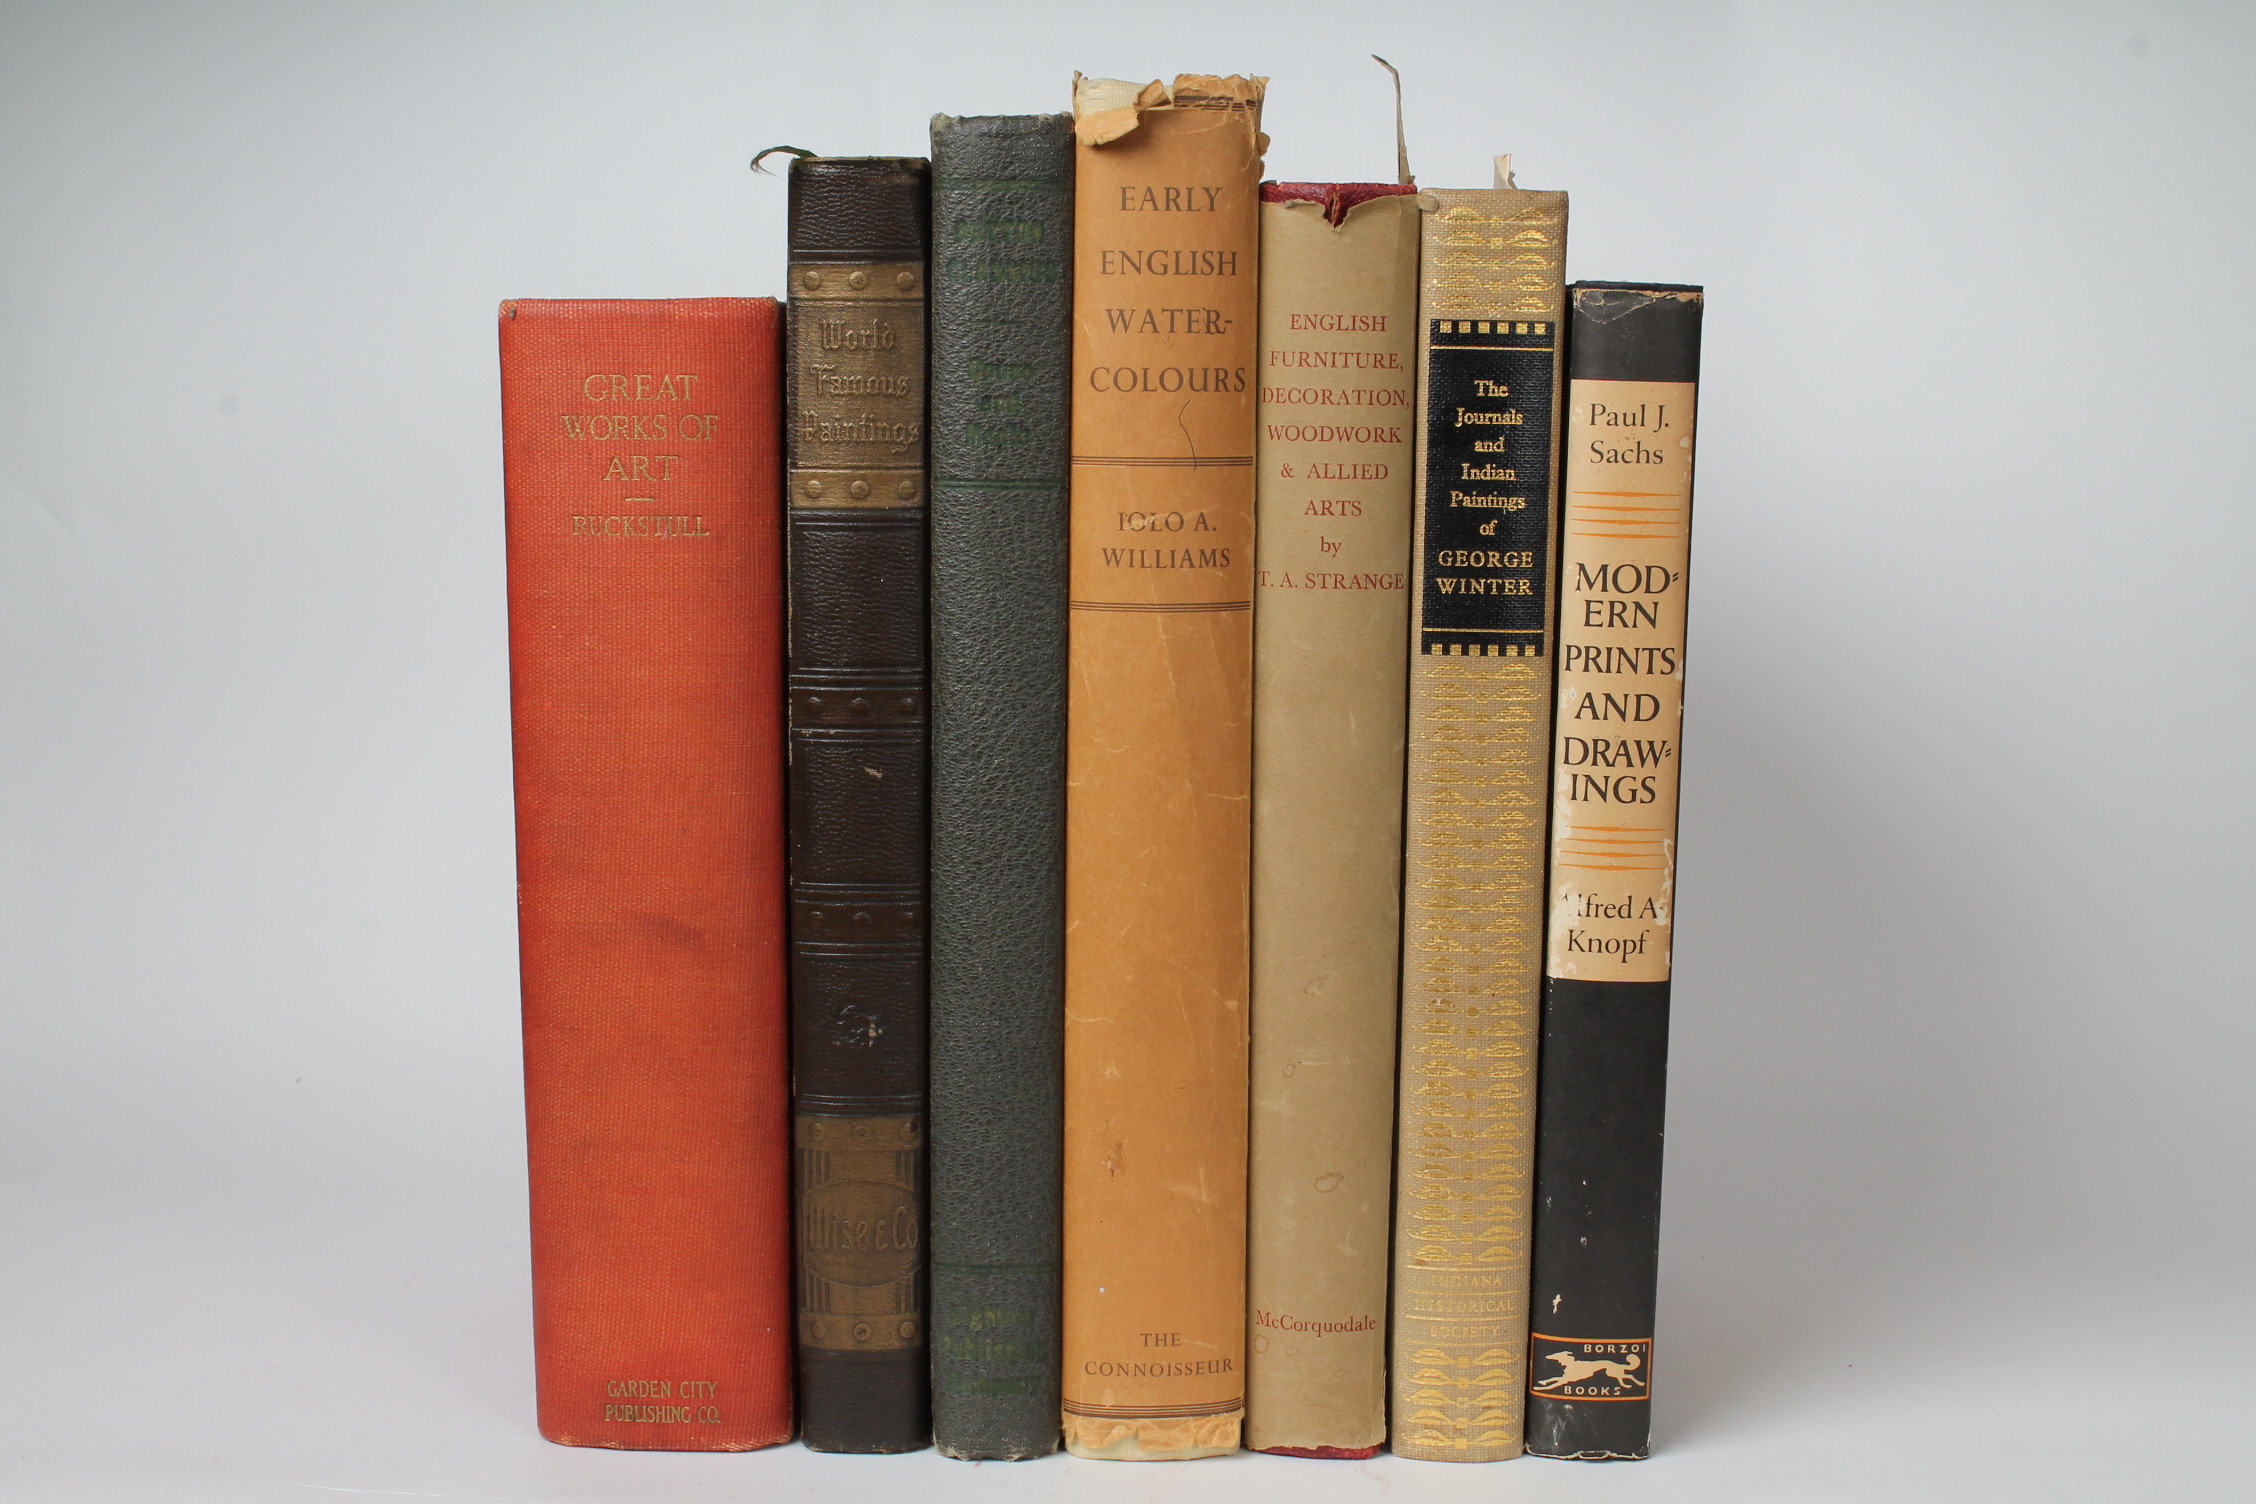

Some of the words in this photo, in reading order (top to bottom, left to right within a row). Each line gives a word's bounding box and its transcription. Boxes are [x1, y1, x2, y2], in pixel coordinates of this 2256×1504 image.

[1120, 186, 1223, 212] EARLY
[1100, 250, 1237, 276] ENGLISH
[1105, 307, 1233, 335] WATER-
[1290, 314, 1387, 332] ENGLISH
[820, 318, 896, 350] World
[1270, 351, 1404, 371] FURNITURE,
[583, 374, 698, 401] GREAT
[810, 363, 911, 396] Famous
[1090, 366, 1246, 393] COLOURS
[1474, 380, 1509, 397] The
[1263, 388, 1410, 409] DECORATION,
[561, 414, 668, 440] WORKS
[678, 414, 719, 440] OF
[1455, 407, 1524, 427] Journals
[1589, 403, 1645, 427] Paul
[1653, 405, 1669, 432] J.
[801, 409, 921, 454] Paintings
[1267, 424, 1403, 443] WOODWORK
[1474, 437, 1505, 452] and
[1590, 440, 1664, 465] Sachs
[602, 455, 679, 481] ART
[1280, 463, 1295, 478] &
[1307, 463, 1389, 480] ALLIED
[1461, 463, 1516, 480] Indian
[1304, 500, 1362, 516] ARTS
[1450, 490, 1527, 511] Paintings
[572, 515, 710, 536] RUCKSTULL
[1118, 511, 1184, 532] IOLO
[1194, 511, 1217, 532] A.
[1480, 520, 1498, 535] of
[1320, 536, 1342, 558] by
[1102, 548, 1230, 569] WILLIAMS
[1438, 550, 1533, 567] GEORGE
[1259, 571, 1274, 587] T.
[1280, 572, 1298, 588] A.
[1305, 573, 1404, 590] STRANGE
[1436, 578, 1533, 595] WINTER
[1583, 599, 1659, 630] ERN
[1564, 645, 1676, 675] PRINTS
[1574, 692, 1660, 722] AND
[1570, 774, 1657, 804] INGS
[1567, 929, 1650, 964] Knopf
[1256, 1310, 1376, 1337] McCorquodale
[1429, 1326, 1500, 1337] SOCIETY
[1140, 1332, 1182, 1347] THE
[1583, 1344, 1646, 1353] BORZOI
[1084, 1358, 1233, 1378] CONNOISSEUR
[607, 1380, 671, 1398] GARDEN
[680, 1381, 718, 1398] CITY
[1564, 1385, 1621, 1396] BOOKS
[605, 1404, 691, 1423] PUBLISHING
[697, 1406, 721, 1423] CO.
